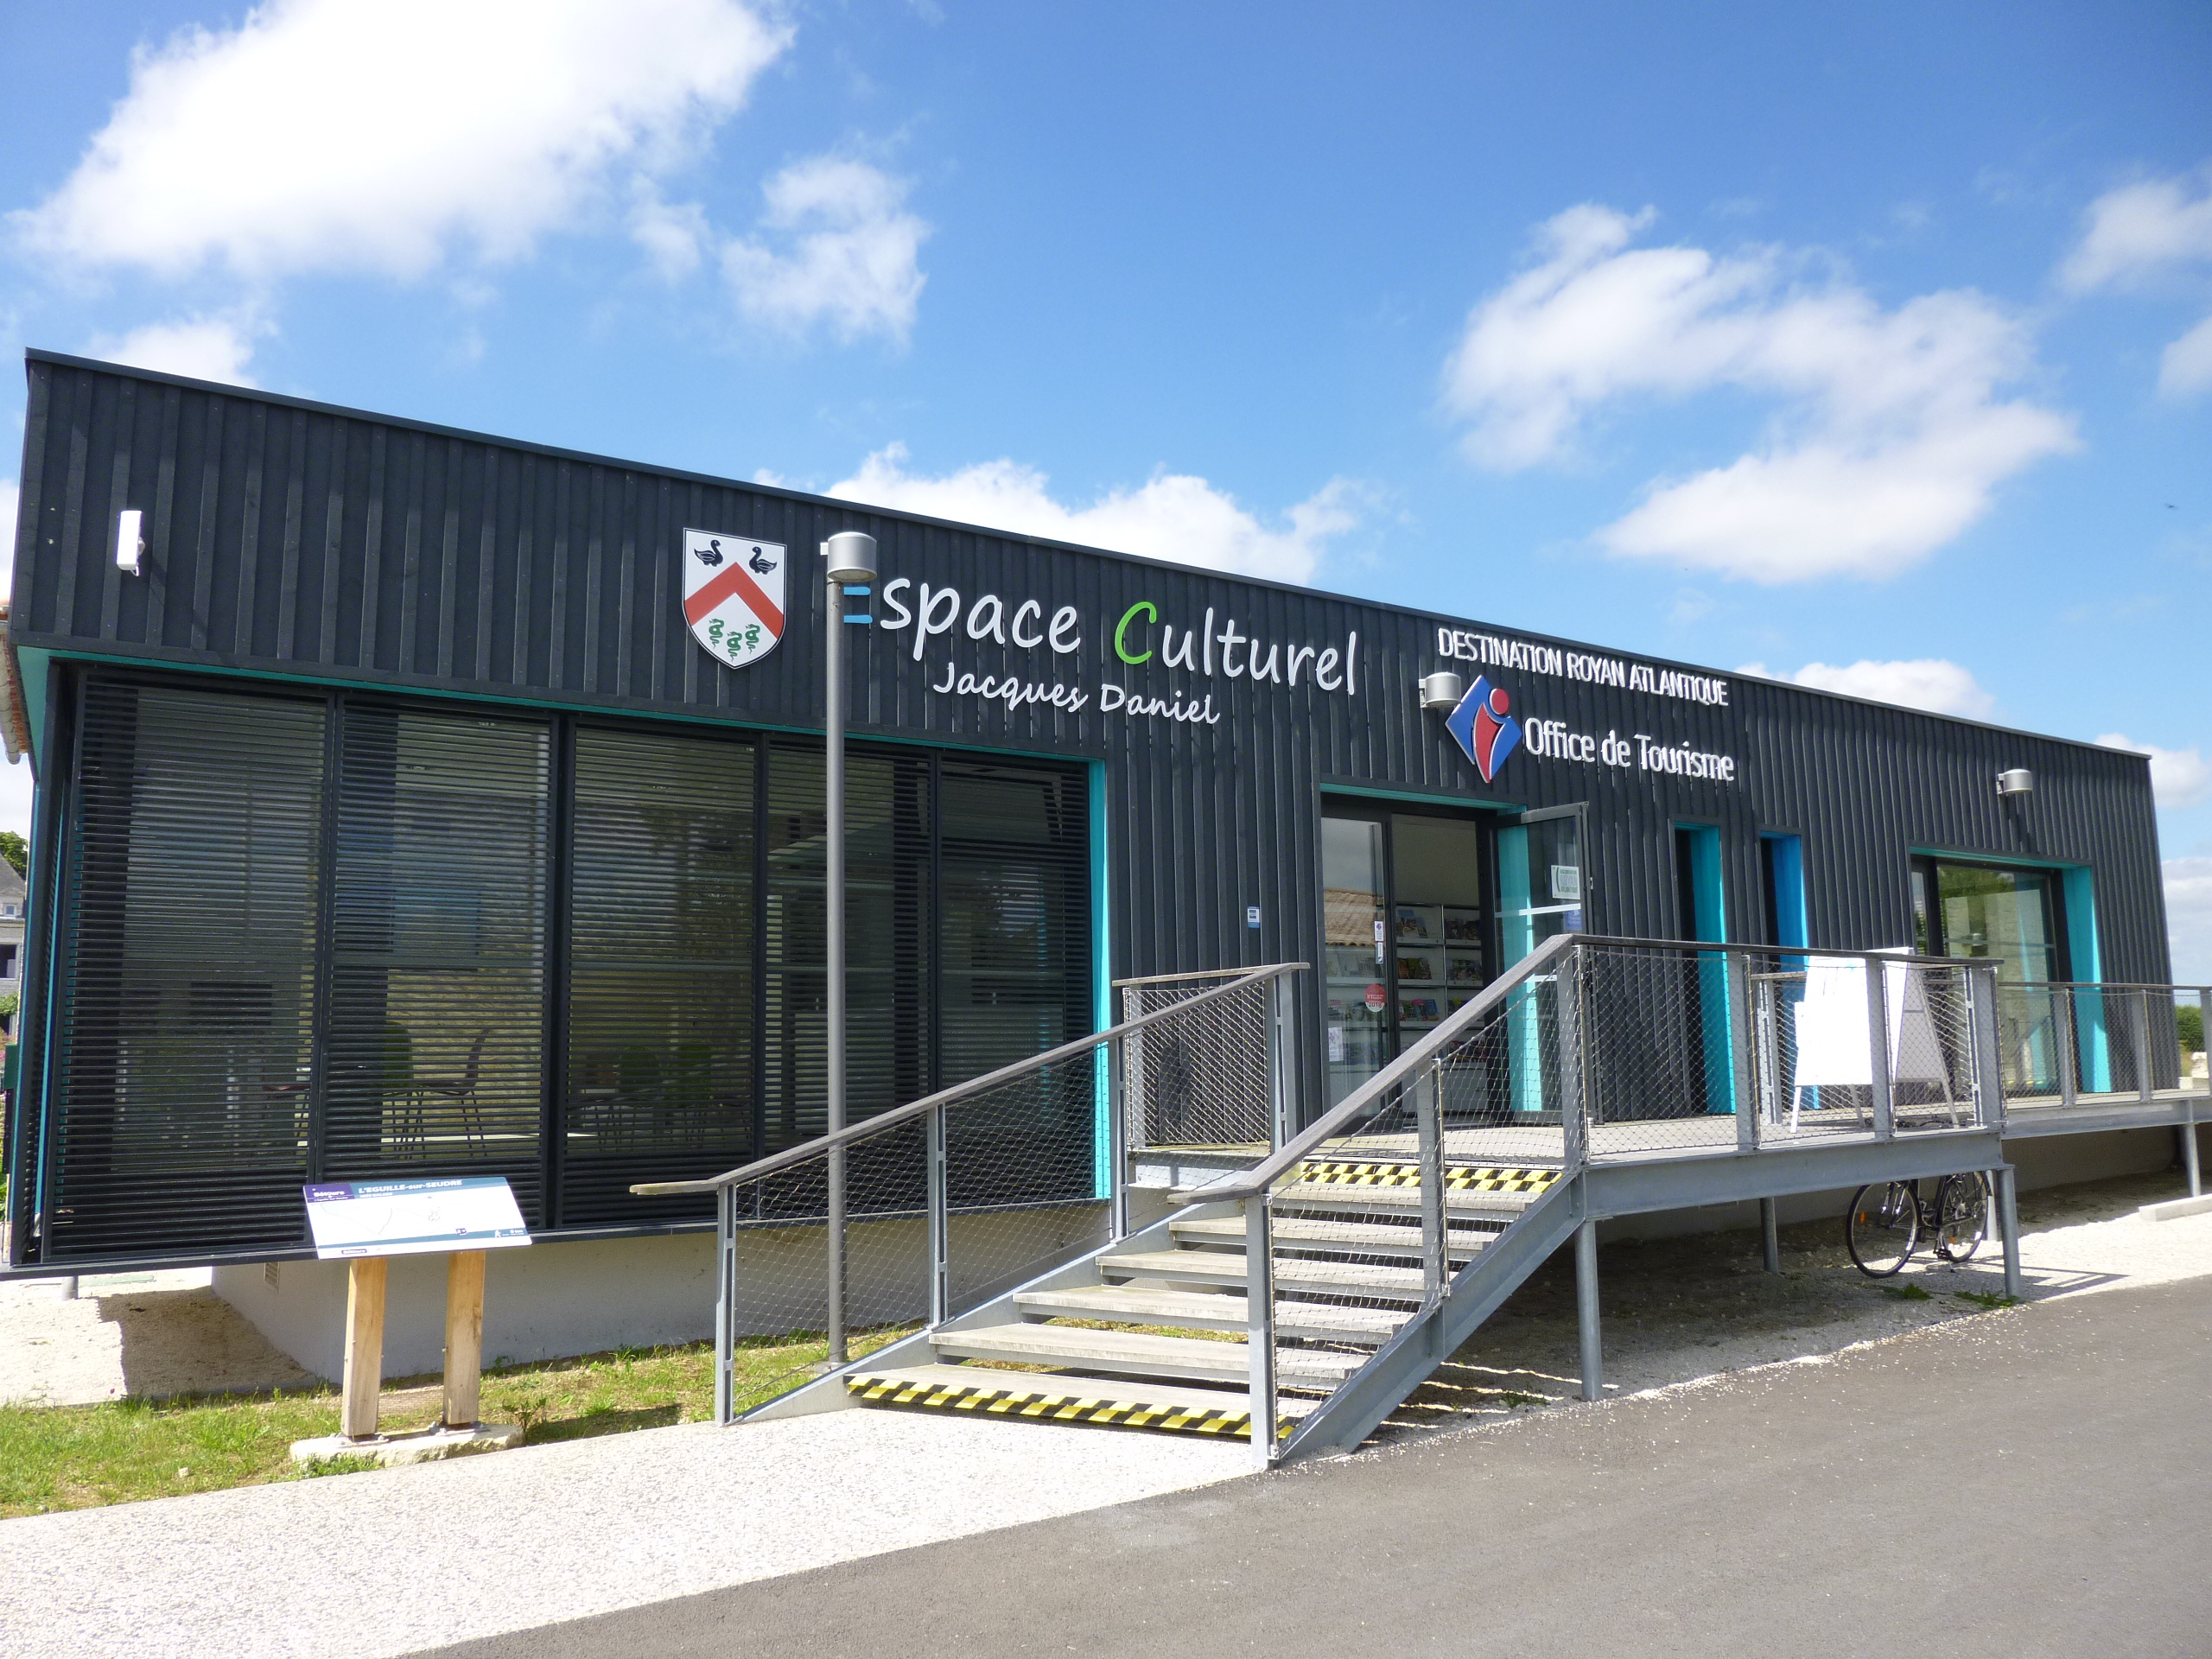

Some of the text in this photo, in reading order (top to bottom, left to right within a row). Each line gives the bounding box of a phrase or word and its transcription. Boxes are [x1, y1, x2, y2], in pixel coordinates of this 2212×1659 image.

[1114, 601, 1356, 695] Culturel
[1437, 627, 1729, 707] DESTINATION ROYAN ATLANTIQUE
[932, 662, 1220, 724] Jacques Daniel
[1523, 717, 1735, 782] Office de Tourisme
